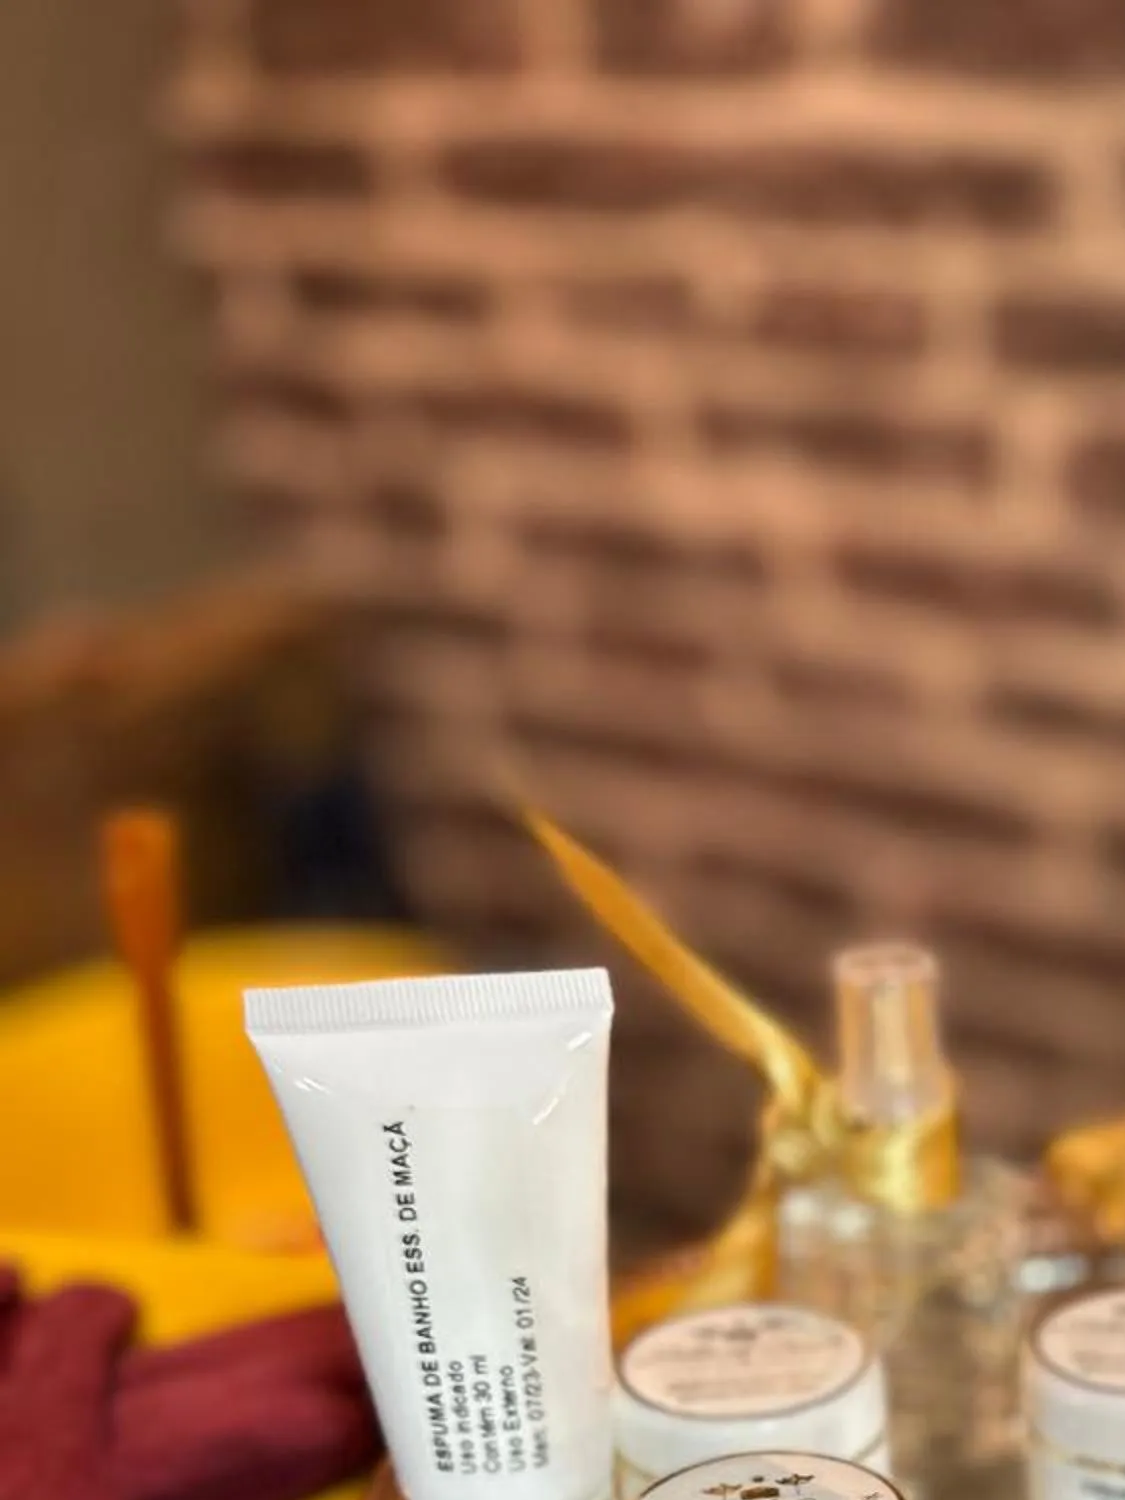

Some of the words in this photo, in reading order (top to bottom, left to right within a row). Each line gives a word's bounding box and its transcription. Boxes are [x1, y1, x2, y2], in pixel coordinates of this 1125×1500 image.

[383, 1121, 412, 1186] MAÇÃ
[397, 1192, 417, 1222] DE
[402, 1229, 425, 1275] ESS.
[408, 1279, 437, 1355] BANHO
[421, 1360, 440, 1388] DE
[477, 1381, 492, 1404] 30
[499, 1364, 521, 1432] Externo
[422, 1394, 454, 1472] ESPUMA
[459, 1441, 476, 1475] Uso
[507, 1441, 526, 1473] Uso
